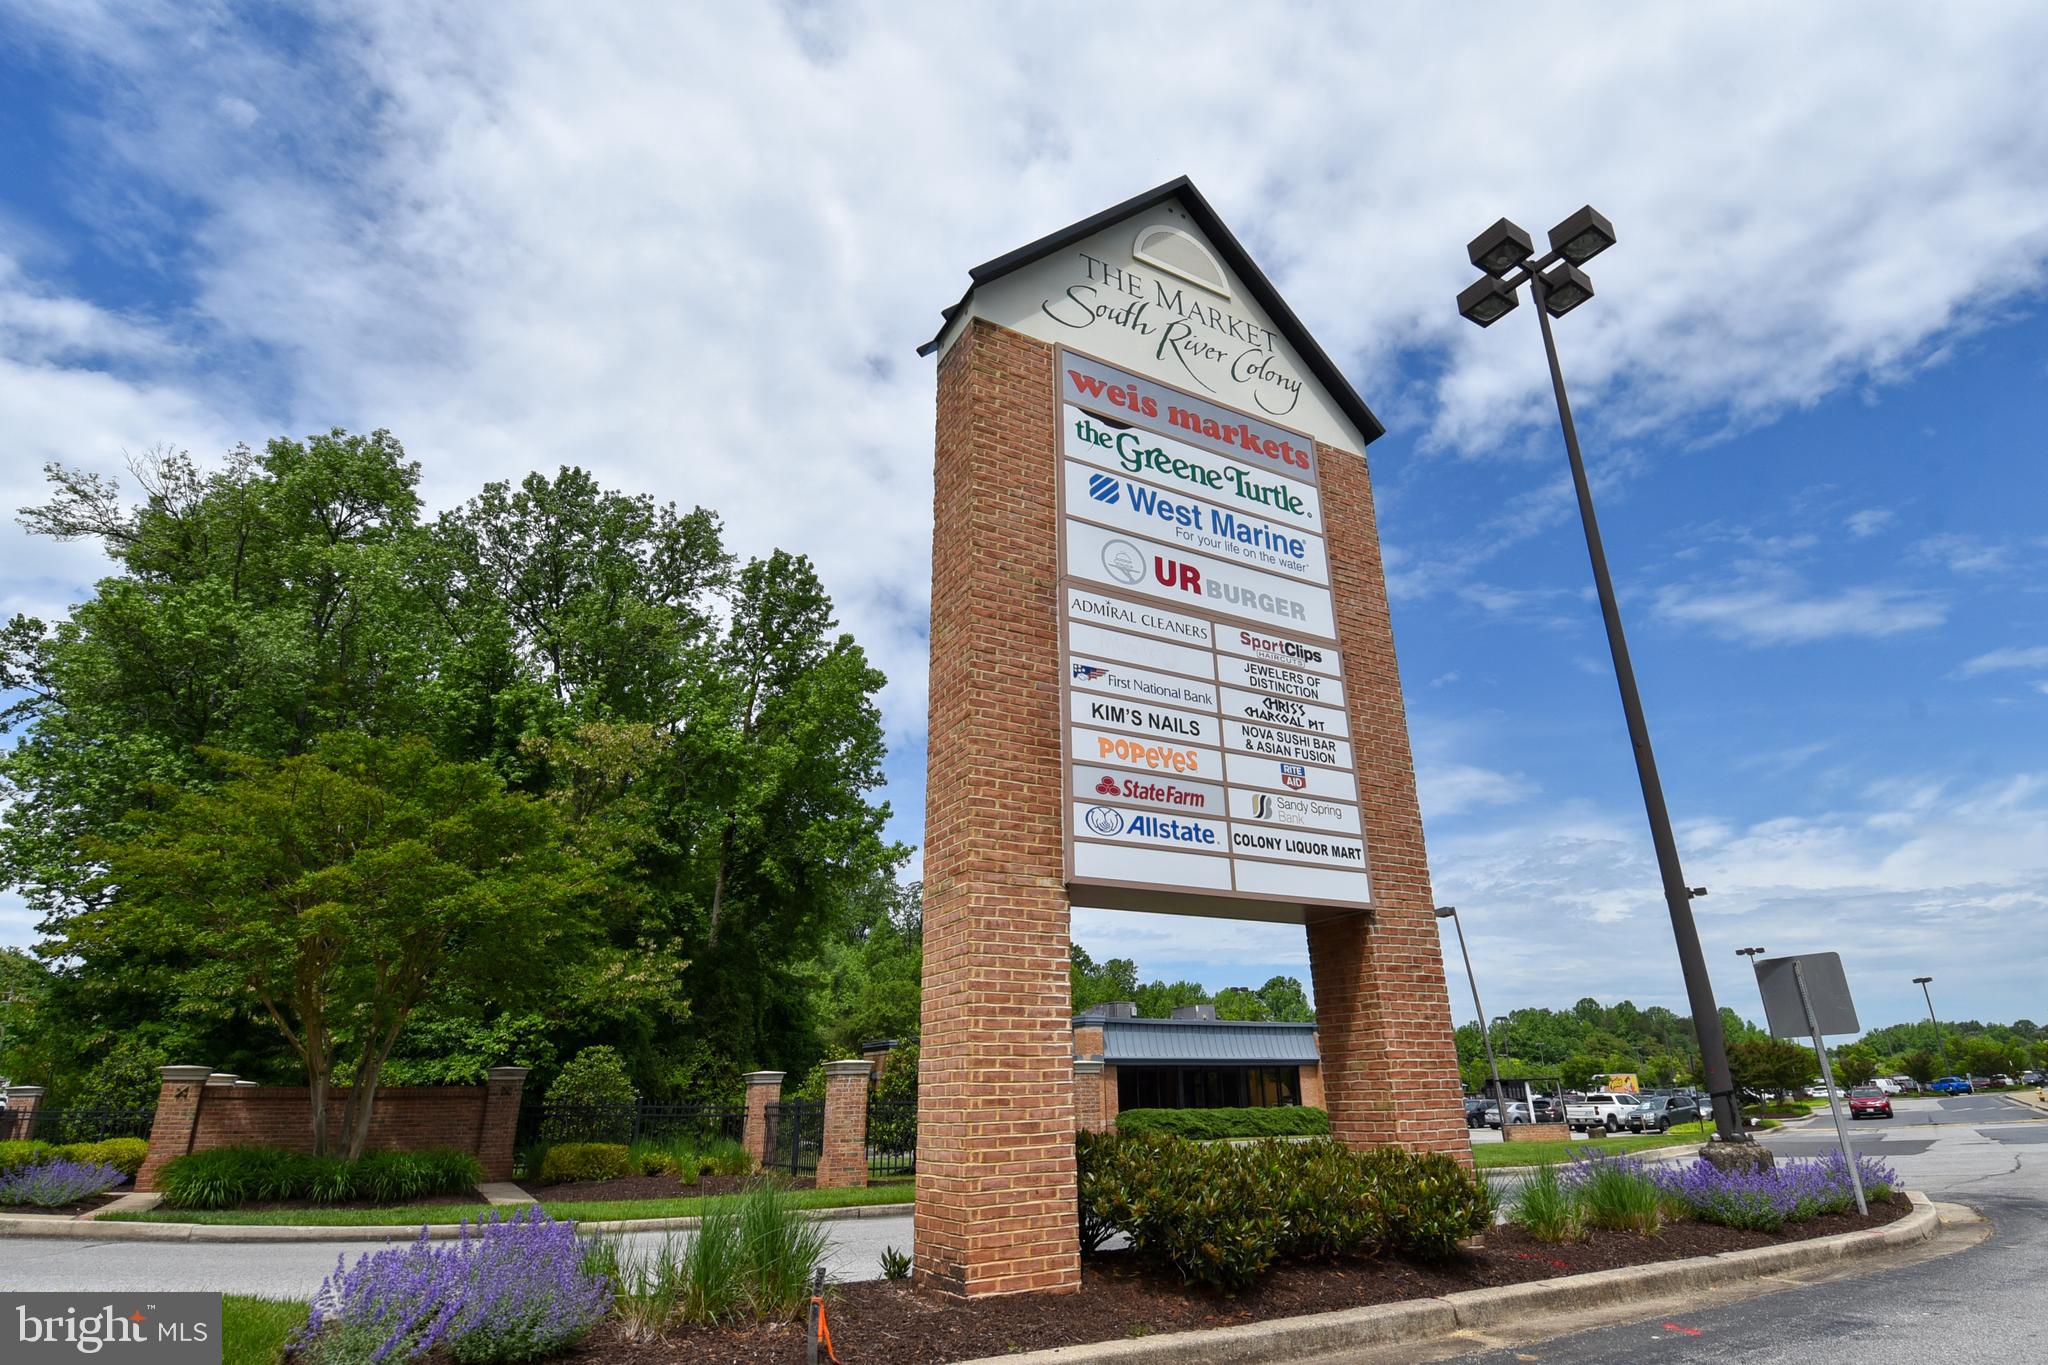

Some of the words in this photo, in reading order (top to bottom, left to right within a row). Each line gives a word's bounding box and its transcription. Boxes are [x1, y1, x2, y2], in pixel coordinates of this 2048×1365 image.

[1080, 253, 1144, 299] THE
[1153, 279, 1278, 352] MARKET
[1041, 285, 1157, 335] South
[1156, 319, 1228, 393] River
[1231, 348, 1302, 415] Colony
[1067, 369, 1158, 418] weis
[1168, 406, 1310, 470] markets
[1075, 420, 1114, 449] the
[1116, 432, 1224, 490] Greene
[1126, 483, 1203, 531] West
[1211, 508, 1306, 559] Marine
[1175, 527, 1195, 542] For
[1197, 533, 1221, 550] your
[1224, 539, 1241, 555] life
[1242, 546, 1258, 560] on
[1259, 550, 1277, 565] the
[1278, 556, 1307, 573] water
[1071, 598, 1137, 624] ADMIRAL
[1141, 614, 1208, 640] CLEANERS
[1258, 651, 1304, 667] HAIRCUTS
[1244, 662, 1304, 685] JEWELERS
[1306, 676, 1321, 688] OF
[1250, 676, 1319, 700] DISTINCTION
[1108, 674, 1132, 690] First
[1133, 679, 1181, 699] National
[1184, 691, 1213, 705] Bank
[1092, 702, 1143, 726] KIM'S
[1148, 712, 1201, 737] NAILS
[1244, 706, 1305, 728] CHARCOAL
[1308, 719, 1326, 732] PIT
[1262, 697, 1306, 717] CHRIS'S
[1241, 725, 1275, 741] NOVA
[1276, 732, 1310, 747] SUSHI
[1313, 739, 1337, 752] BAR
[1245, 739, 1254, 750] &
[1257, 742, 1292, 757] ASIAN
[1295, 747, 1336, 764] FUSION
[1283, 764, 1303, 776] RITE
[1286, 776, 1303, 787] AID
[1277, 797, 1309, 813] Sandy
[1310, 801, 1342, 819] Spring
[1278, 811, 1305, 825] Bank
[1126, 815, 1215, 844] Allstate
[1233, 832, 1282, 851] COLONY
[1285, 839, 1328, 856] LIQUOR
[1331, 845, 1362, 861] MART
